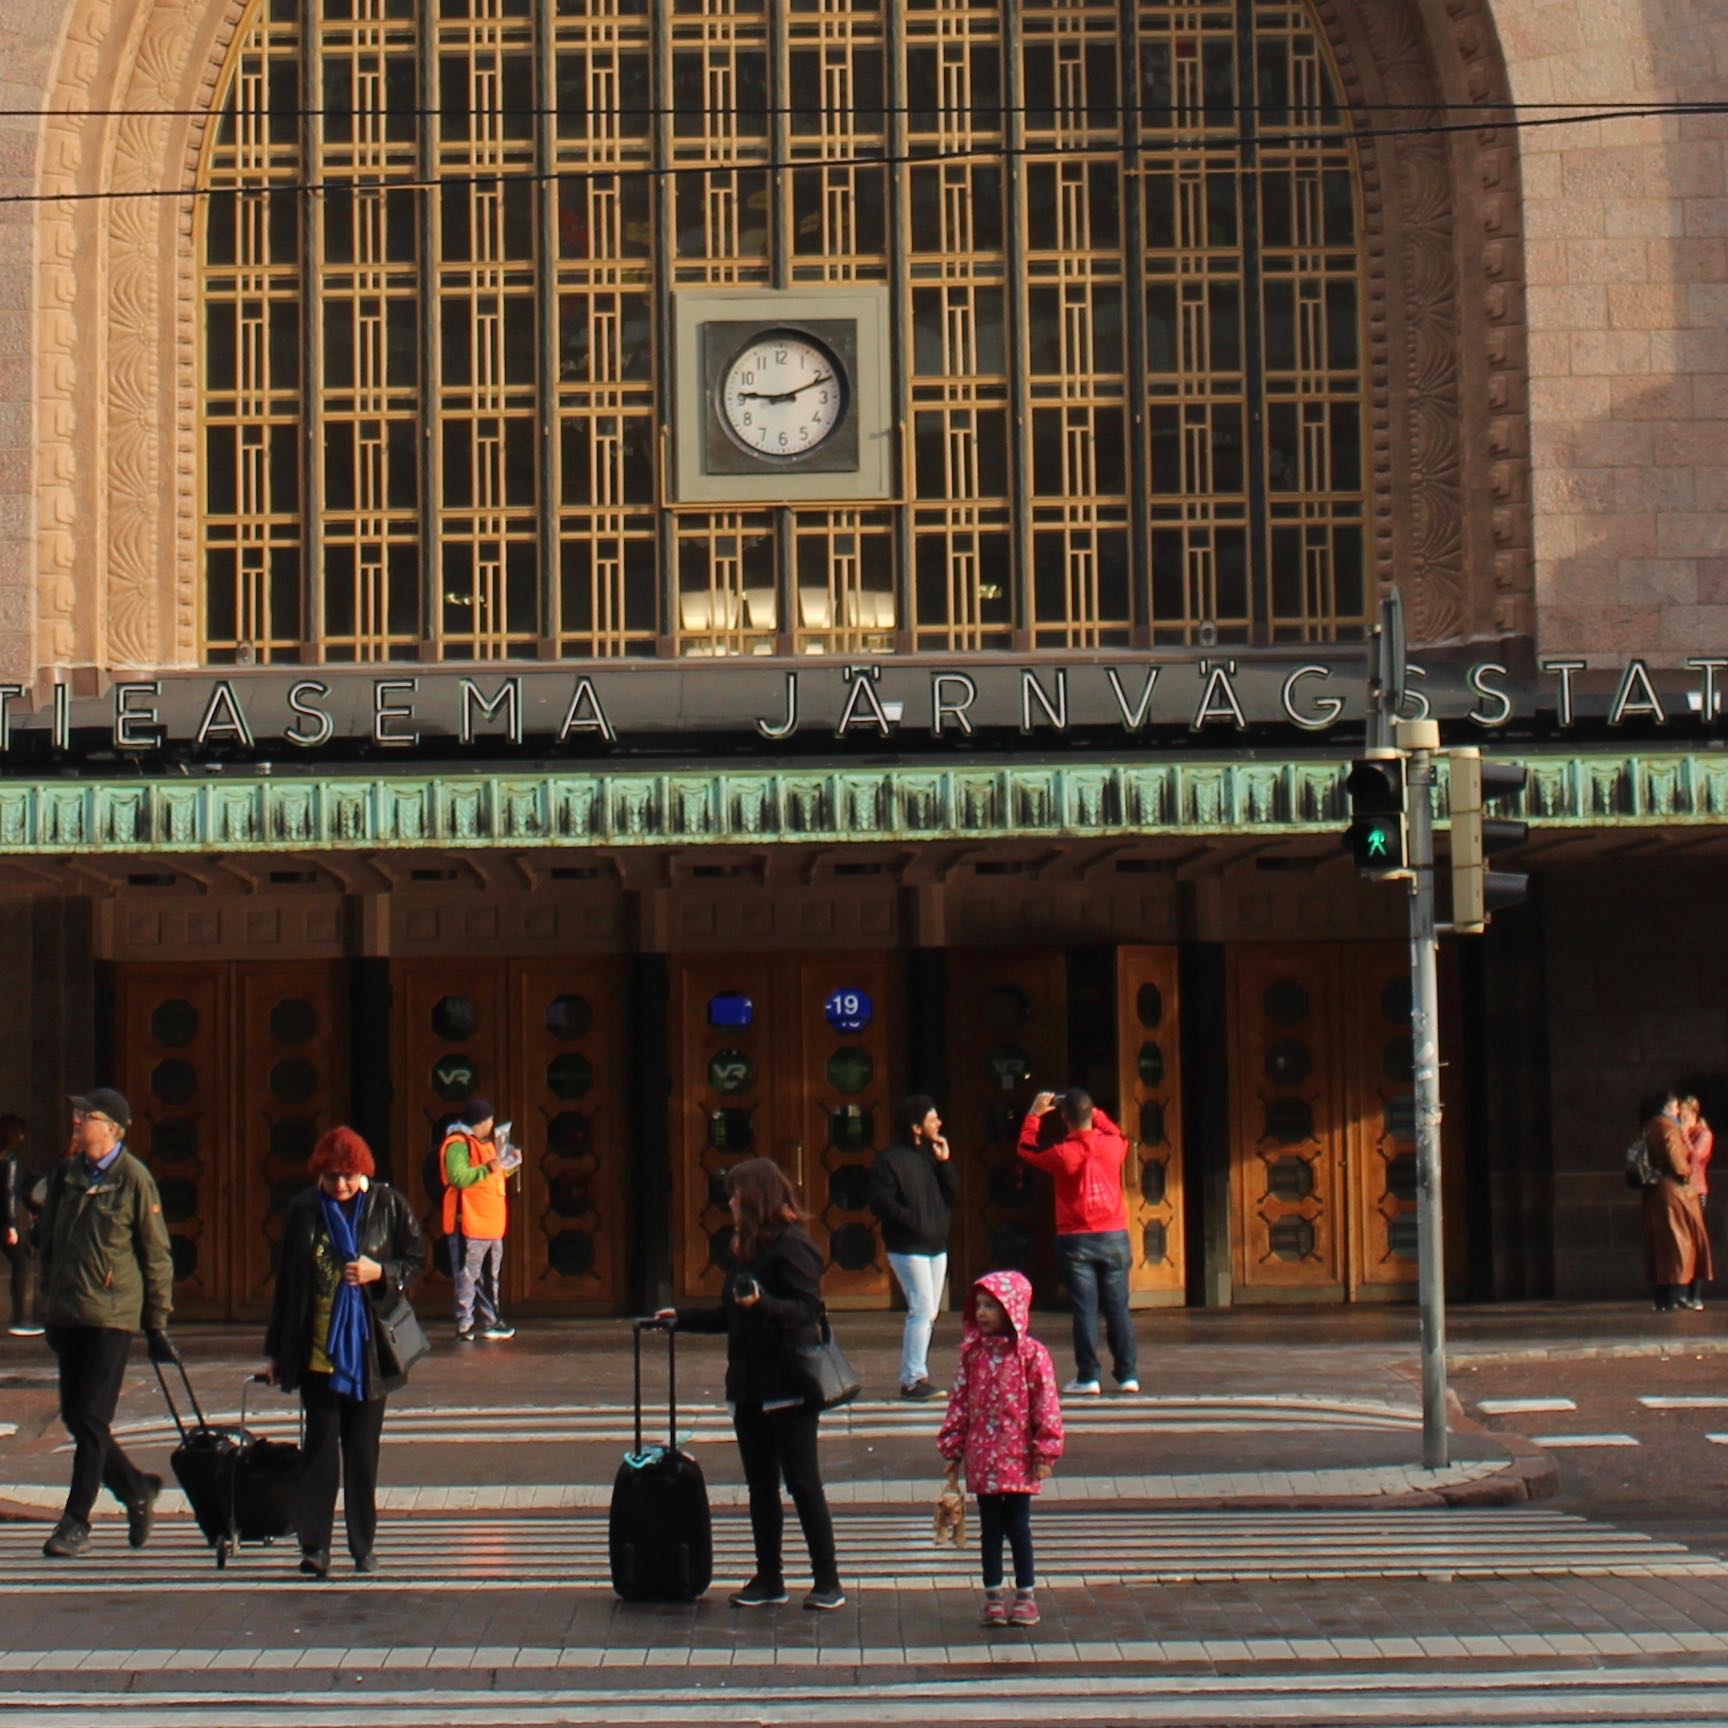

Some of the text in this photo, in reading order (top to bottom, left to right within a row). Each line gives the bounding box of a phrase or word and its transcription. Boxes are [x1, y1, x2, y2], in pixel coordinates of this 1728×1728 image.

[756, 356, 767, 370] 11
[775, 350, 788, 364] 12
[741, 370, 754, 385] 10
[813, 369, 823, 384] 2
[737, 392, 746, 406] 9
[818, 390, 828, 404] 3
[743, 412, 752, 426] 8
[812, 412, 822, 423] 4
[757, 427, 767, 441] 7
[778, 431, 788, 446] 6
[799, 427, 809, 441] 5
[437, 1069, 471, 1085] VR
[712, 1064, 747, 1079] VR
